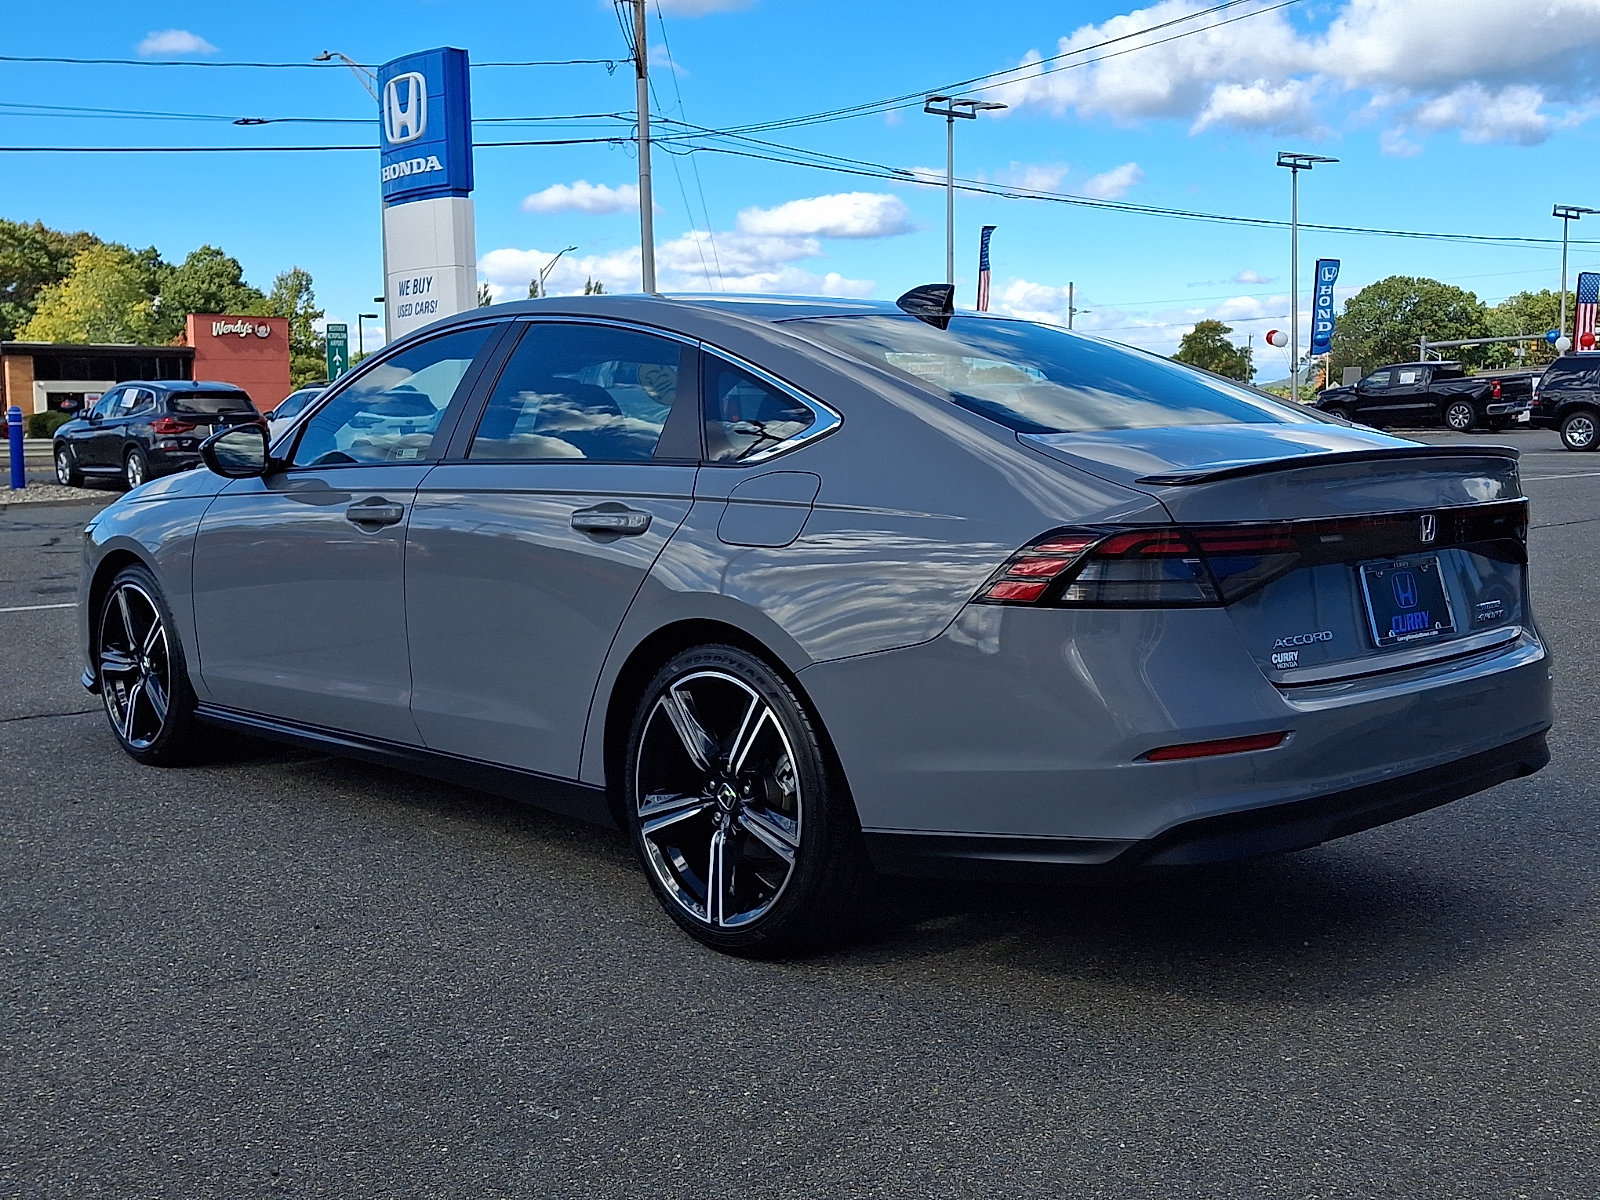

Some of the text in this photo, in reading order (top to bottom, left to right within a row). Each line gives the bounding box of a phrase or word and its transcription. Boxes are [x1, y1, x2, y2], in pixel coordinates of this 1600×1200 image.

[381, 155, 443, 182] HONDA
[398, 276, 433, 296] WE BUY
[397, 300, 438, 318] USED CARS!
[1317, 285, 1333, 333] HOND
[212, 319, 253, 337] Wendy's
[1391, 610, 1429, 633] CURRY
[1272, 631, 1333, 649] ACCORD
[1271, 651, 1299, 664] CURRY
[1276, 661, 1298, 669] HONDA
